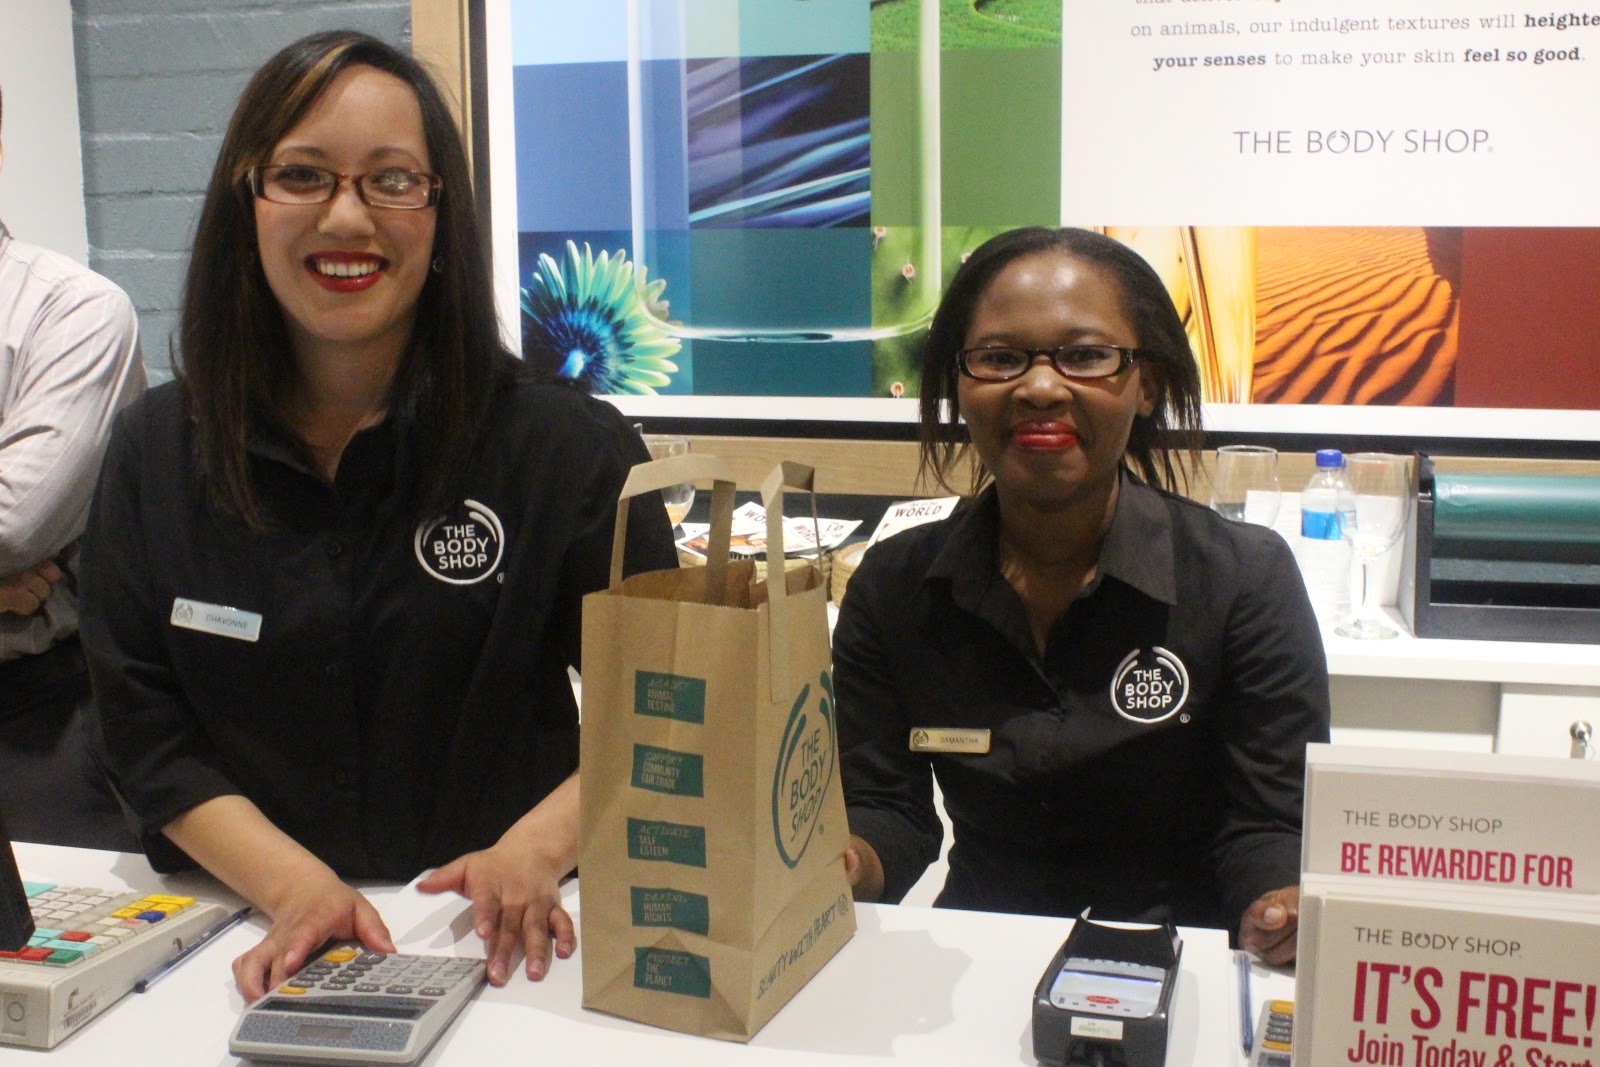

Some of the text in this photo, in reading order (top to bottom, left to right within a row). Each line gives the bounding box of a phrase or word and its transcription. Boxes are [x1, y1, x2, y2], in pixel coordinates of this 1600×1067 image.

[1131, 24, 1152, 37] on
[1160, 20, 1240, 36] animals,
[1249, 19, 1282, 33] our
[1290, 17, 1380, 35] indulgent
[1388, 16, 1470, 31] textures
[1480, 14, 1516, 29] will
[1153, 47, 1585, 71] your senses to make your skin feel so good.
[1233, 130, 1292, 154] THE
[1306, 129, 1394, 154] BODY
[895, 505, 942, 518] WORLD
[442, 524, 475, 539] THE
[433, 536, 489, 556] BODY
[438, 553, 488, 570] SHOP
[1132, 668, 1162, 682] THE
[1125, 680, 1175, 697] BODY
[1126, 694, 1172, 709] SHOP
[801, 727, 820, 767] THE
[940, 736, 979, 744] SAMANTHA
[791, 749, 827, 811] BODY
[790, 787, 821, 842] SHOP
[1343, 810, 1503, 834] THE BODY SHOP
[1340, 841, 1574, 888] BE REWARDED FOR
[1354, 927, 1521, 957] THE BODY SHOP
[645, 973, 673, 987] PLANET
[1353, 960, 1444, 1030] IT'S
[1456, 970, 1598, 1048] FREE!
[1347, 1029, 1404, 1067] Join
[1411, 1035, 1486, 1067] Today
[1490, 1044, 1514, 1067] &
